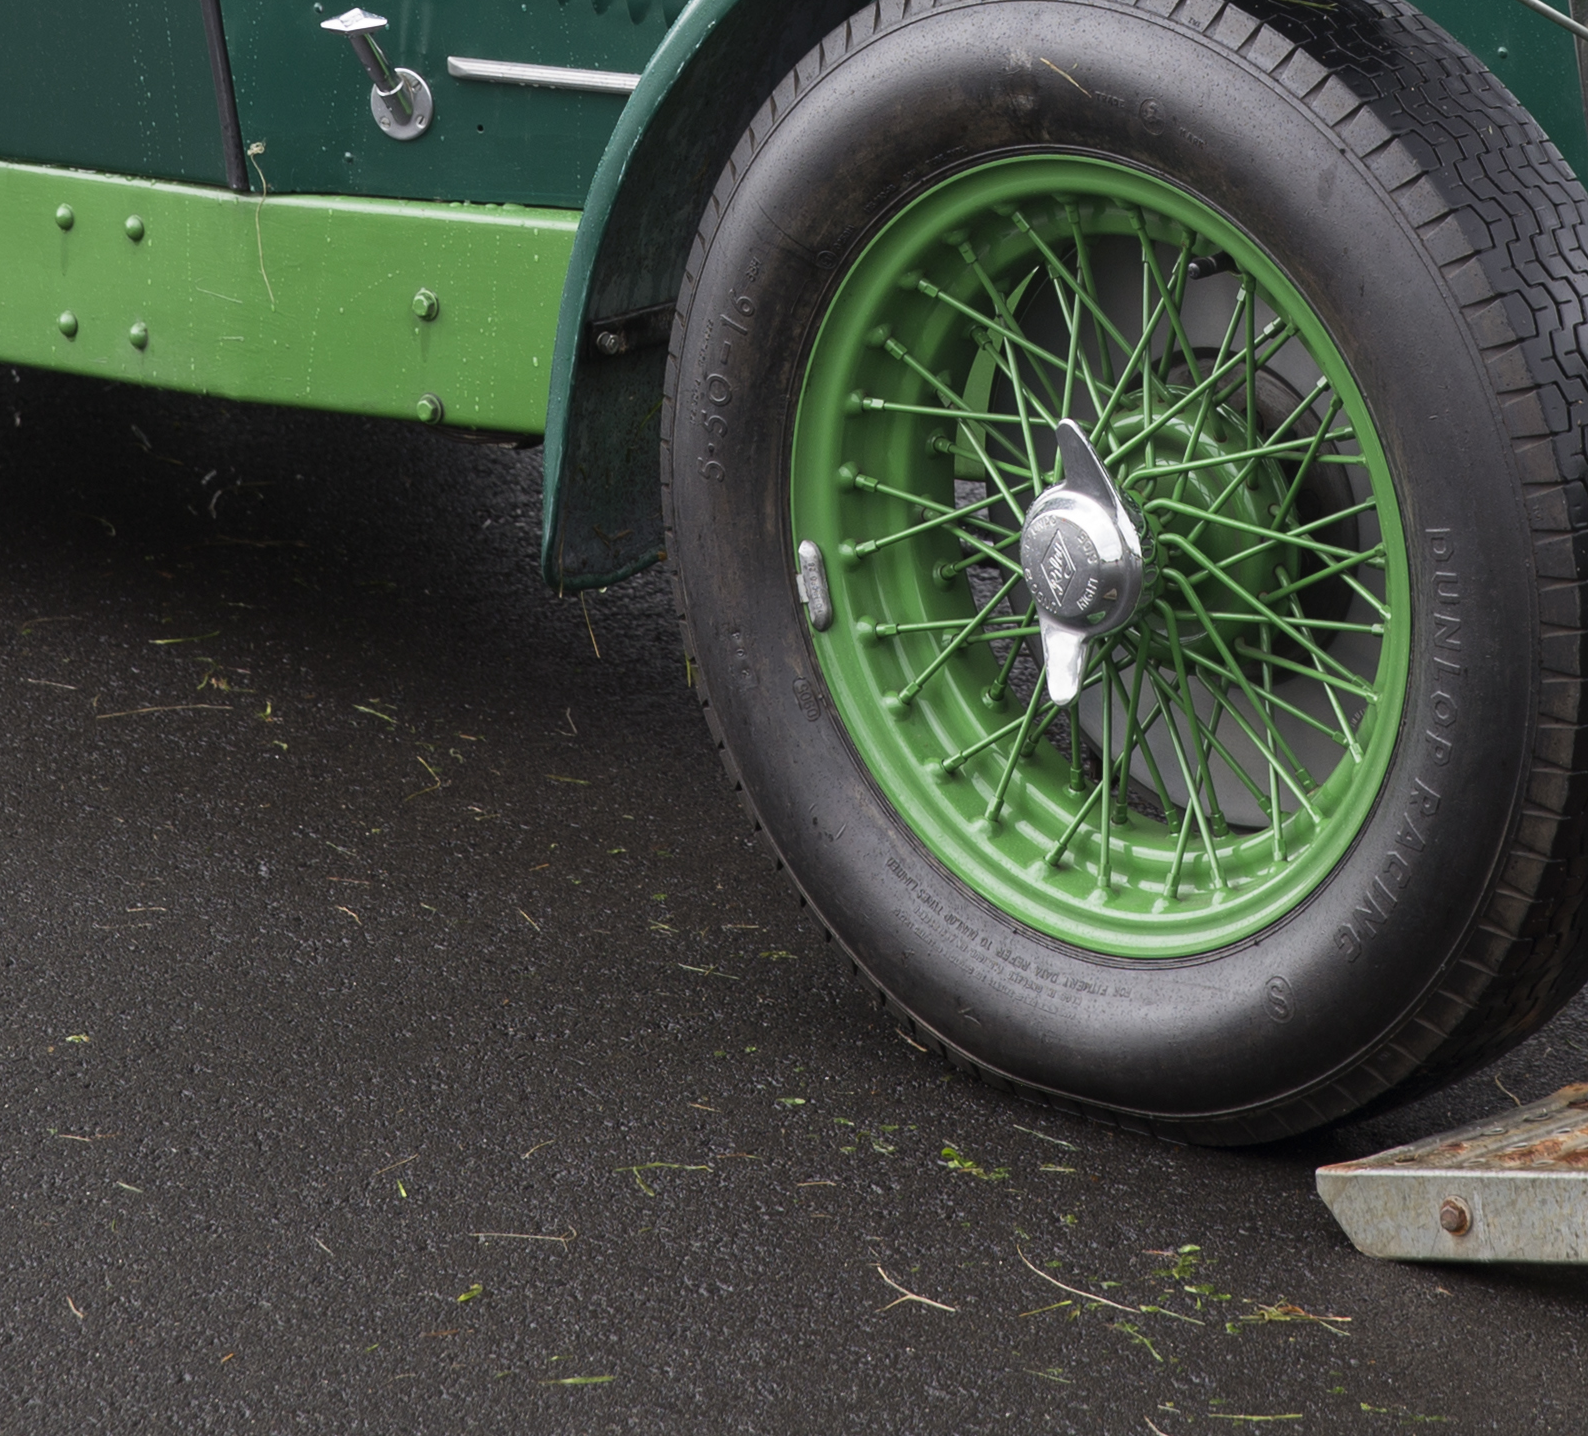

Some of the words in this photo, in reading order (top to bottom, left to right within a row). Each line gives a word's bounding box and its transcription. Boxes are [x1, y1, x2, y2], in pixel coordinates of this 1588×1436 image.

[1076, 577, 1099, 611] RIGHT
[1425, 527, 1461, 768] DUNLOP
[886, 857, 919, 891] LIMITED
[1332, 777, 1441, 964] RACING
[916, 889, 944, 916] TYRES
[944, 914, 979, 941] DUNLOP
[980, 937, 993, 951] TO
[995, 946, 1031, 972] REFER
[1034, 966, 1059, 984] DATA
[1062, 977, 1109, 996] FITMENT
[1114, 984, 1133, 998] FOR
